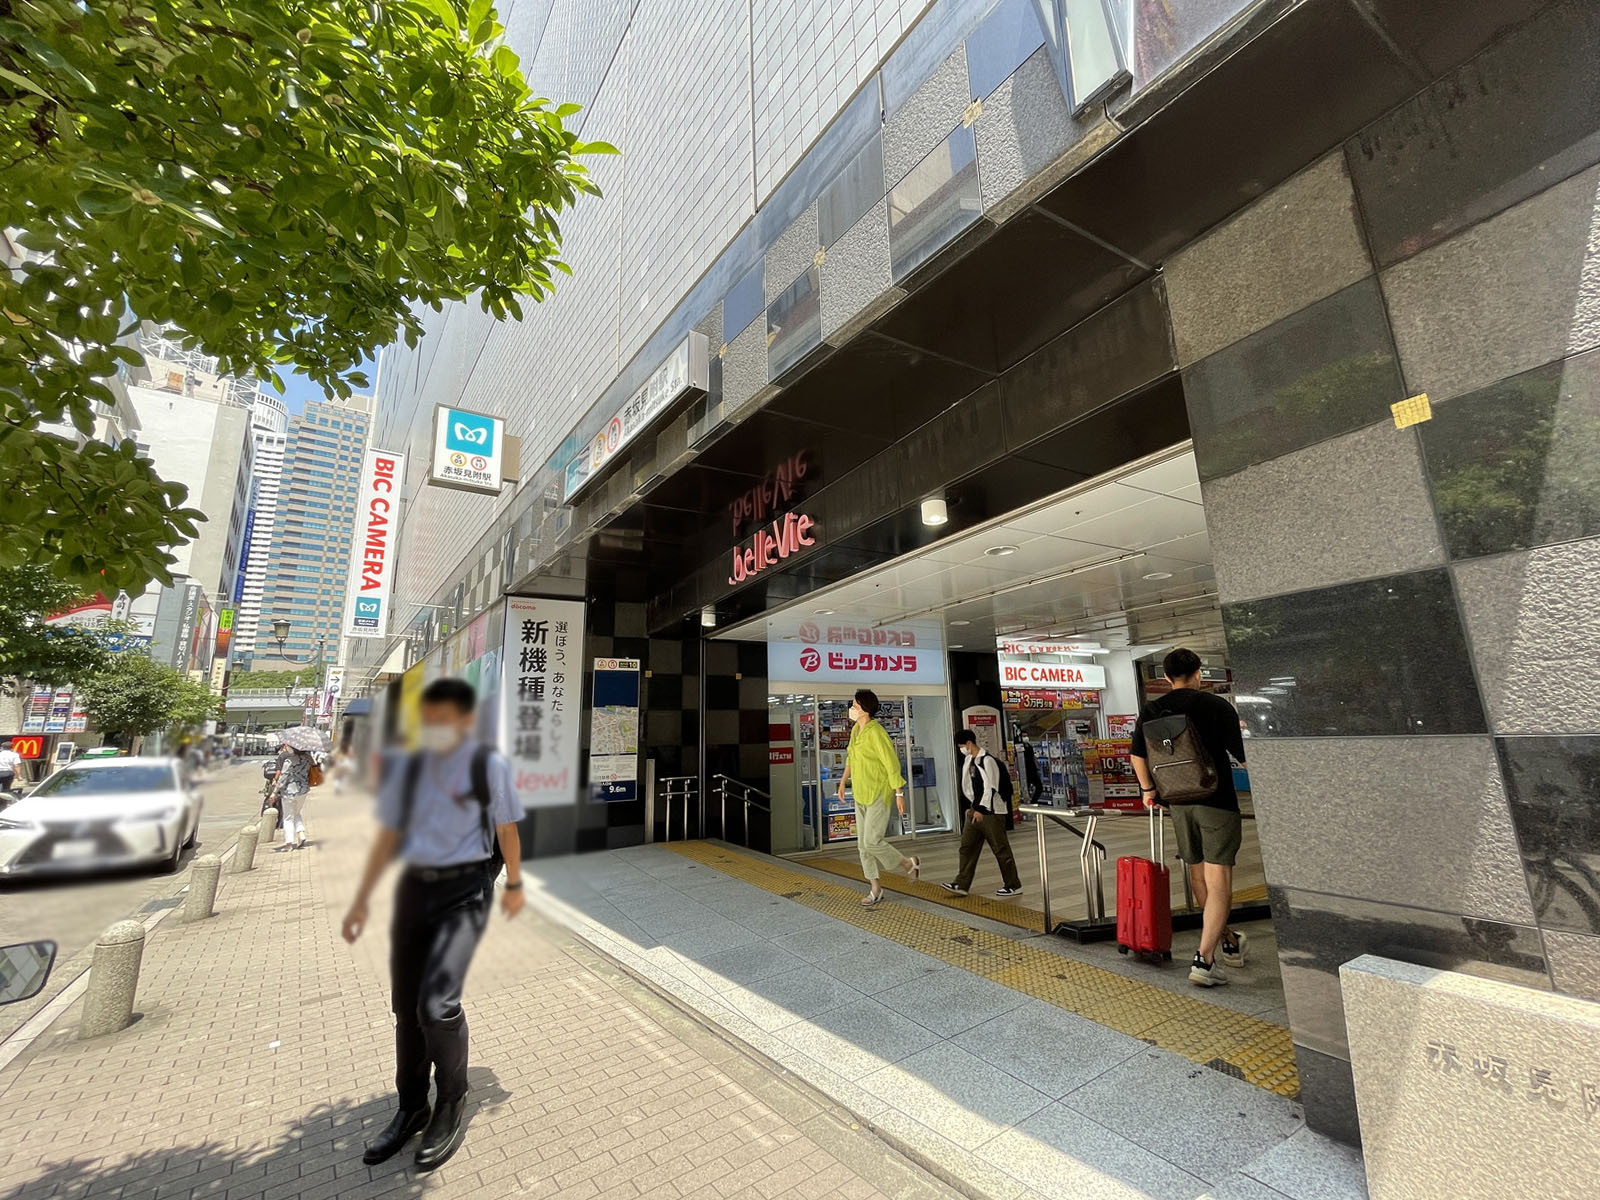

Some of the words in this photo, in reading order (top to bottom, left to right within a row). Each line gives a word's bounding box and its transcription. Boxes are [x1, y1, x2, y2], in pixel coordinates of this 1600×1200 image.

[372, 457, 396, 493] BIC
[443, 466, 492, 481] 赤坂見附駅
[360, 497, 391, 591] CAMERA
[728, 512, 815, 585] belleVie
[828, 652, 917, 672] ビックカメラ
[1004, 666, 1027, 681] BIC
[1031, 667, 1084, 683] CAMERA
[515, 618, 550, 762] 新機種登場
[609, 785, 627, 793] 9.6m
